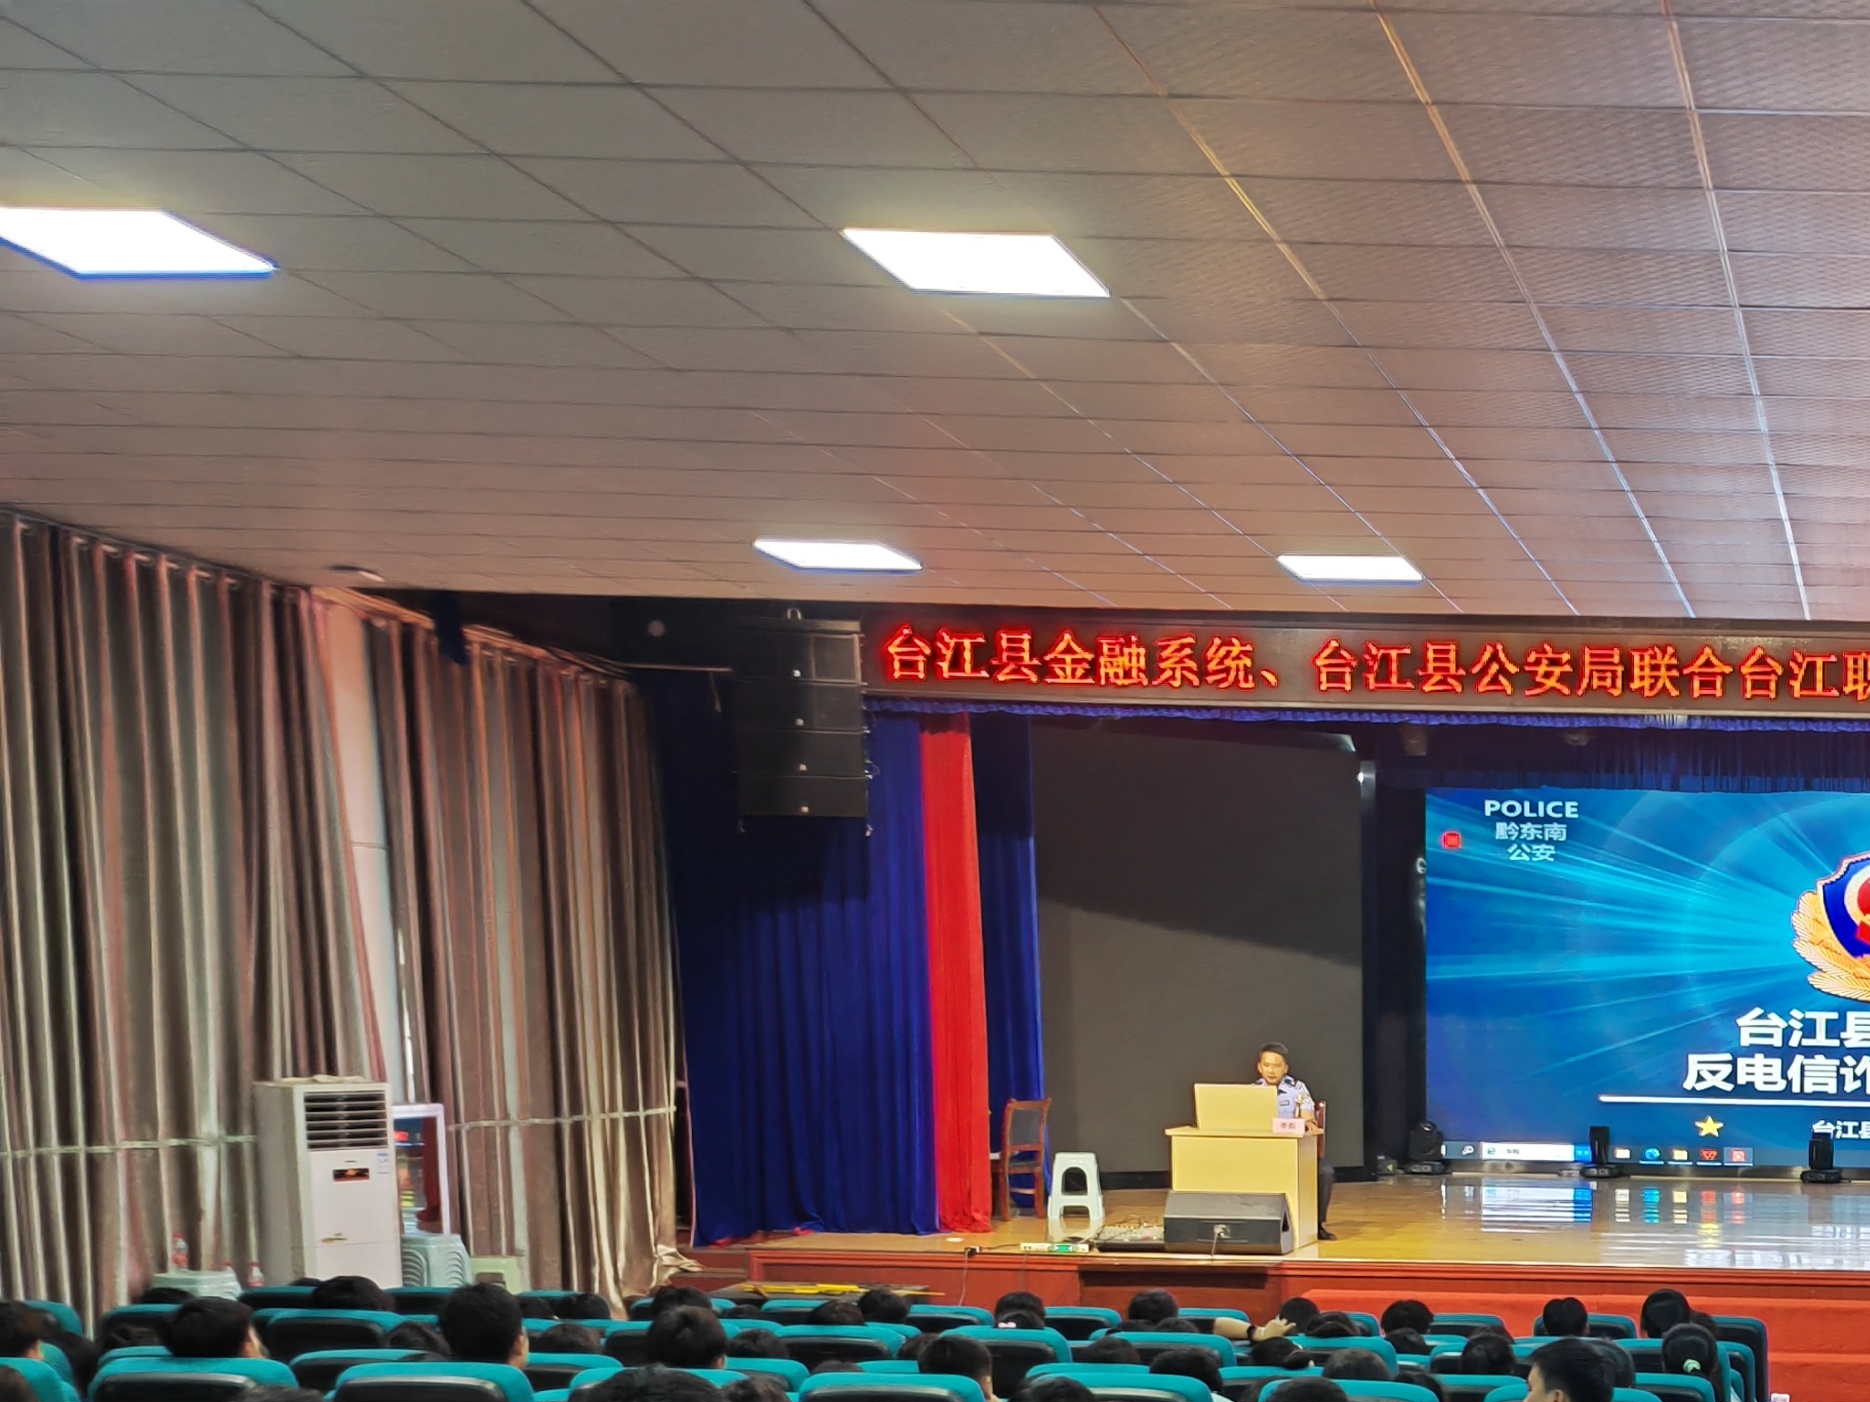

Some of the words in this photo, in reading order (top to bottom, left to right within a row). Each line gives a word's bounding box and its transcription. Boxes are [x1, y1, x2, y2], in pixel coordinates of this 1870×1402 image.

[1484, 800, 1579, 819] POLICE
[1495, 822, 1567, 841] 黔东南
[1507, 843, 1556, 862] 公安
